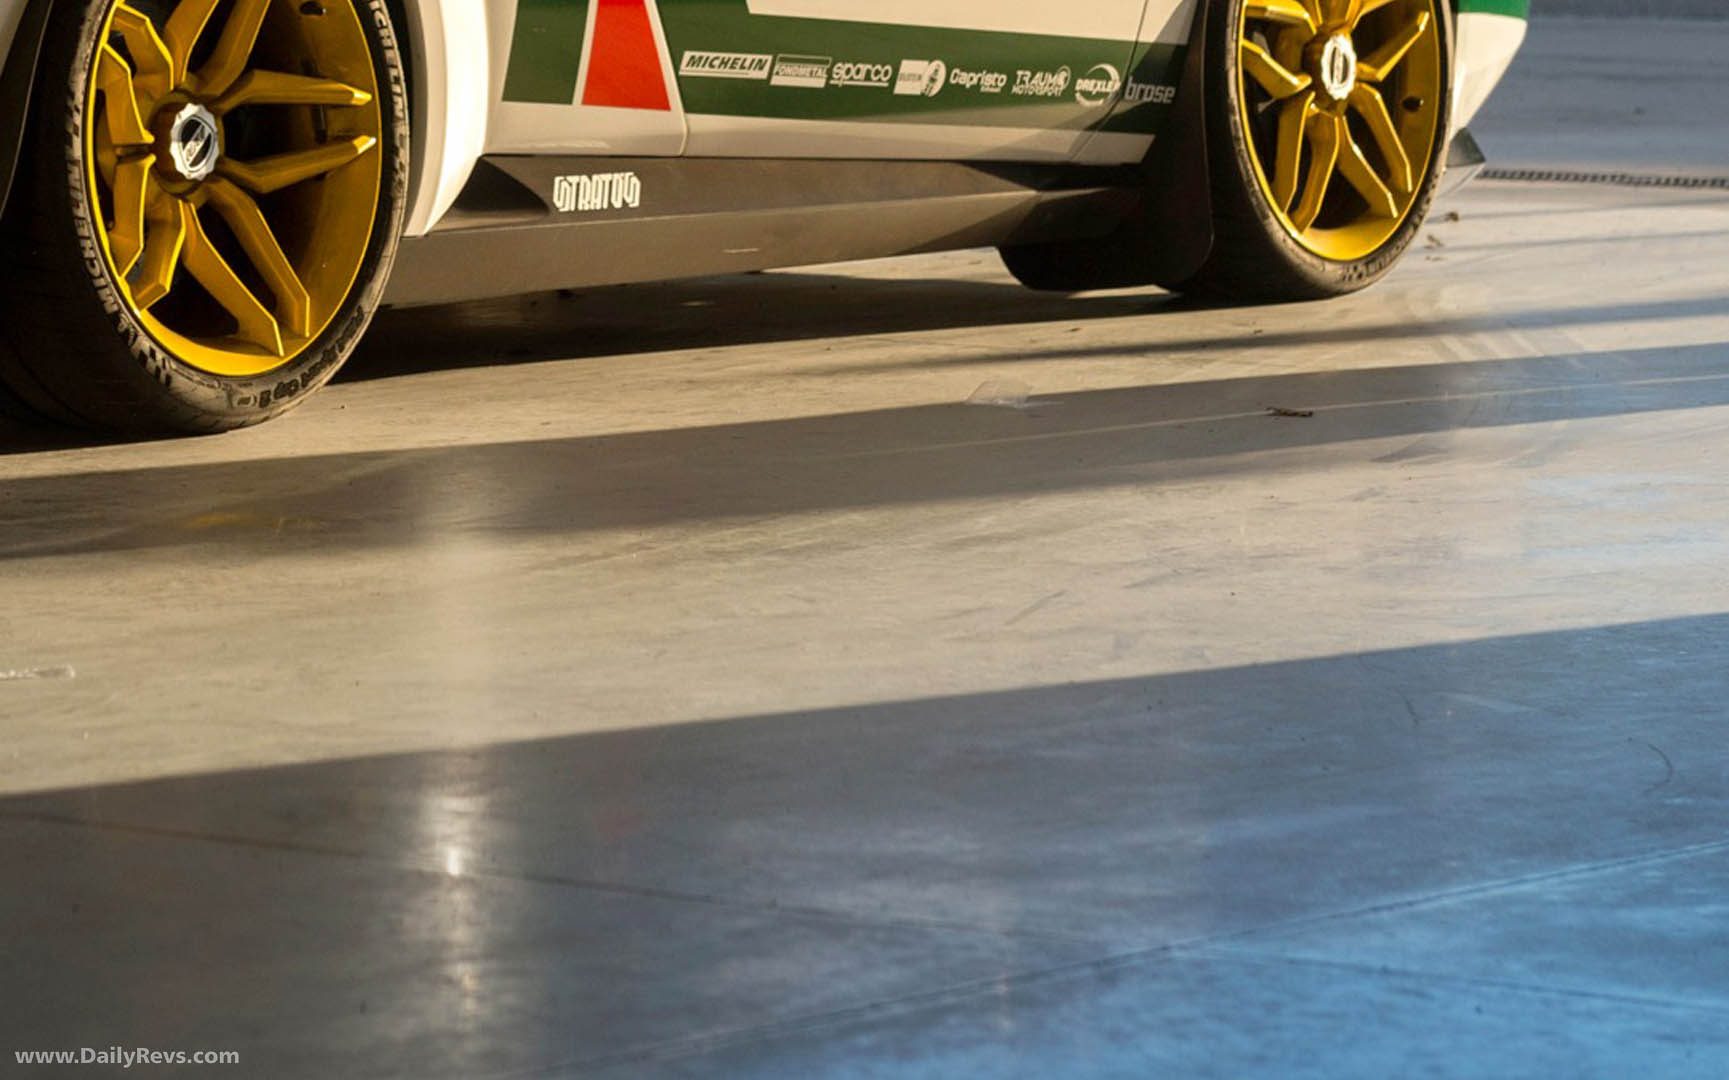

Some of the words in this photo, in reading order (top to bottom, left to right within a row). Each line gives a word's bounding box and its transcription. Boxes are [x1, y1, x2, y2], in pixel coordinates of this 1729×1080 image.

[685, 54, 769, 72] MICHELIN
[832, 62, 892, 87] sparco
[949, 68, 1008, 88] Capristo
[1124, 76, 1176, 103] brose
[67, 160, 121, 314] MICHELIN
